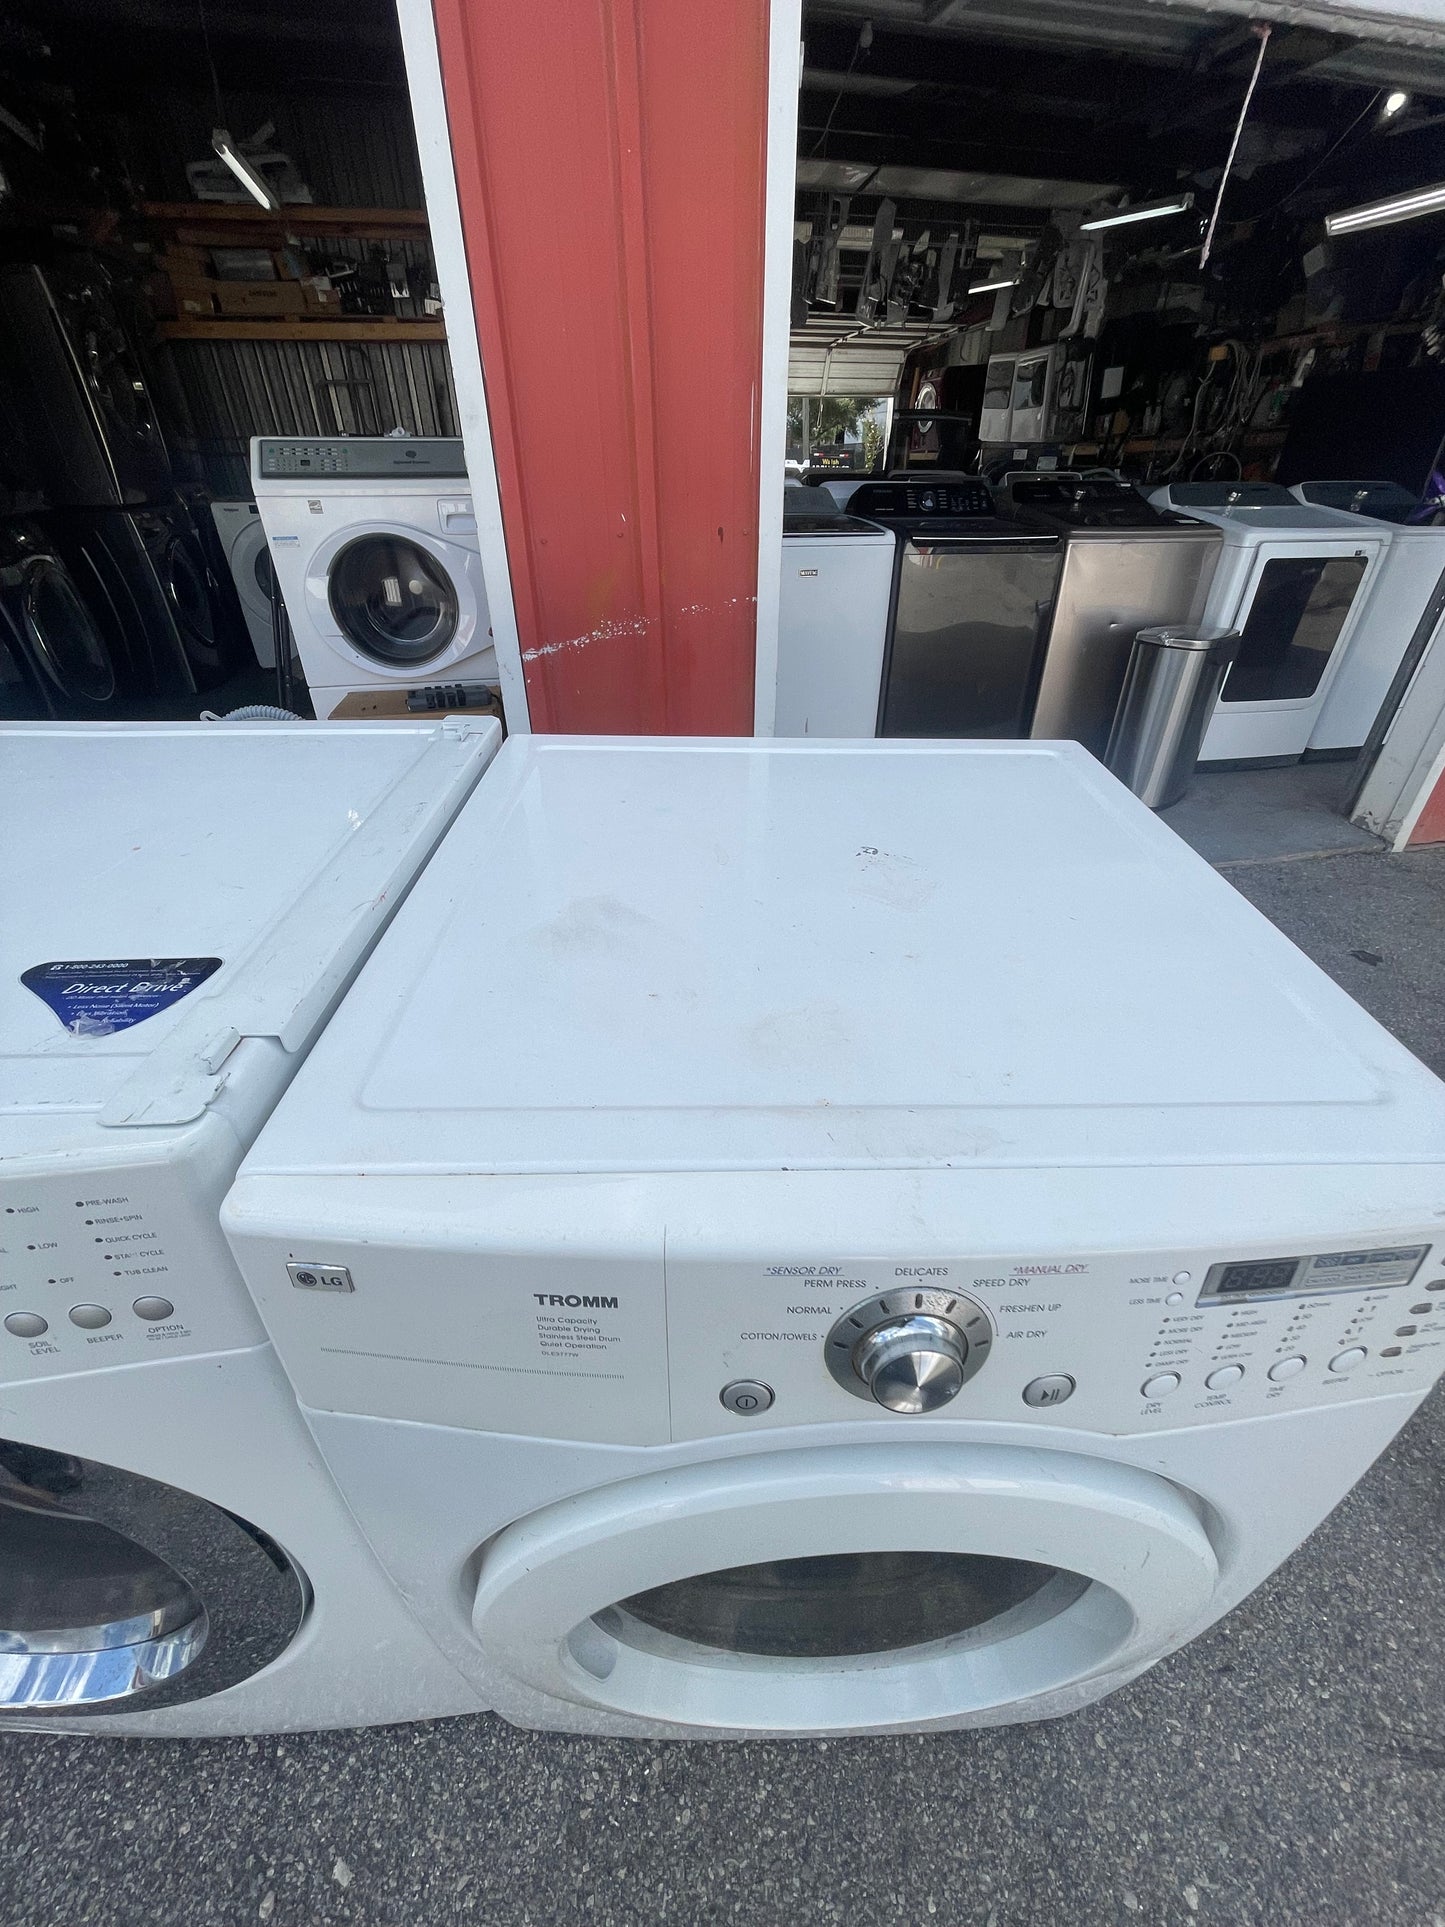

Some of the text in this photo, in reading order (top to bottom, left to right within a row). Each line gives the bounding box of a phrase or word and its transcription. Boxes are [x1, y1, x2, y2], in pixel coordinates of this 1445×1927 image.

[62, 982, 184, 995] Direct Drive
[86, 1196, 129, 1206] PRE-WASH
[94, 1214, 143, 1224] RINSE+SPIN
[104, 1232, 157, 1244] QUICK CYCLE
[38, 1242, 58, 1250] LOW
[139, 1249, 164, 1258] CYCLE
[142, 1266, 168, 1275] CLEAN
[895, 1267, 949, 1276] DELICATES
[320, 1276, 343, 1286] LG
[804, 1280, 867, 1288] PERM PRESS
[972, 1278, 1031, 1288] SPEED DRY
[533, 1294, 618, 1308] TROMM
[786, 1306, 832, 1314] NORMAL
[1000, 1304, 1062, 1313] FRESHEN UP
[557, 1316, 598, 1325] Capacity
[148, 1324, 184, 1334] OPTION
[573, 1326, 600, 1334] Drying
[86, 1333, 124, 1344] BEEPER
[538, 1332, 574, 1341] Stainless
[740, 1332, 818, 1341] COTTON/TOWELS
[1006, 1330, 1047, 1339] AIR DRY
[564, 1342, 608, 1350] Operation
[30, 1346, 61, 1356] LEVEL
